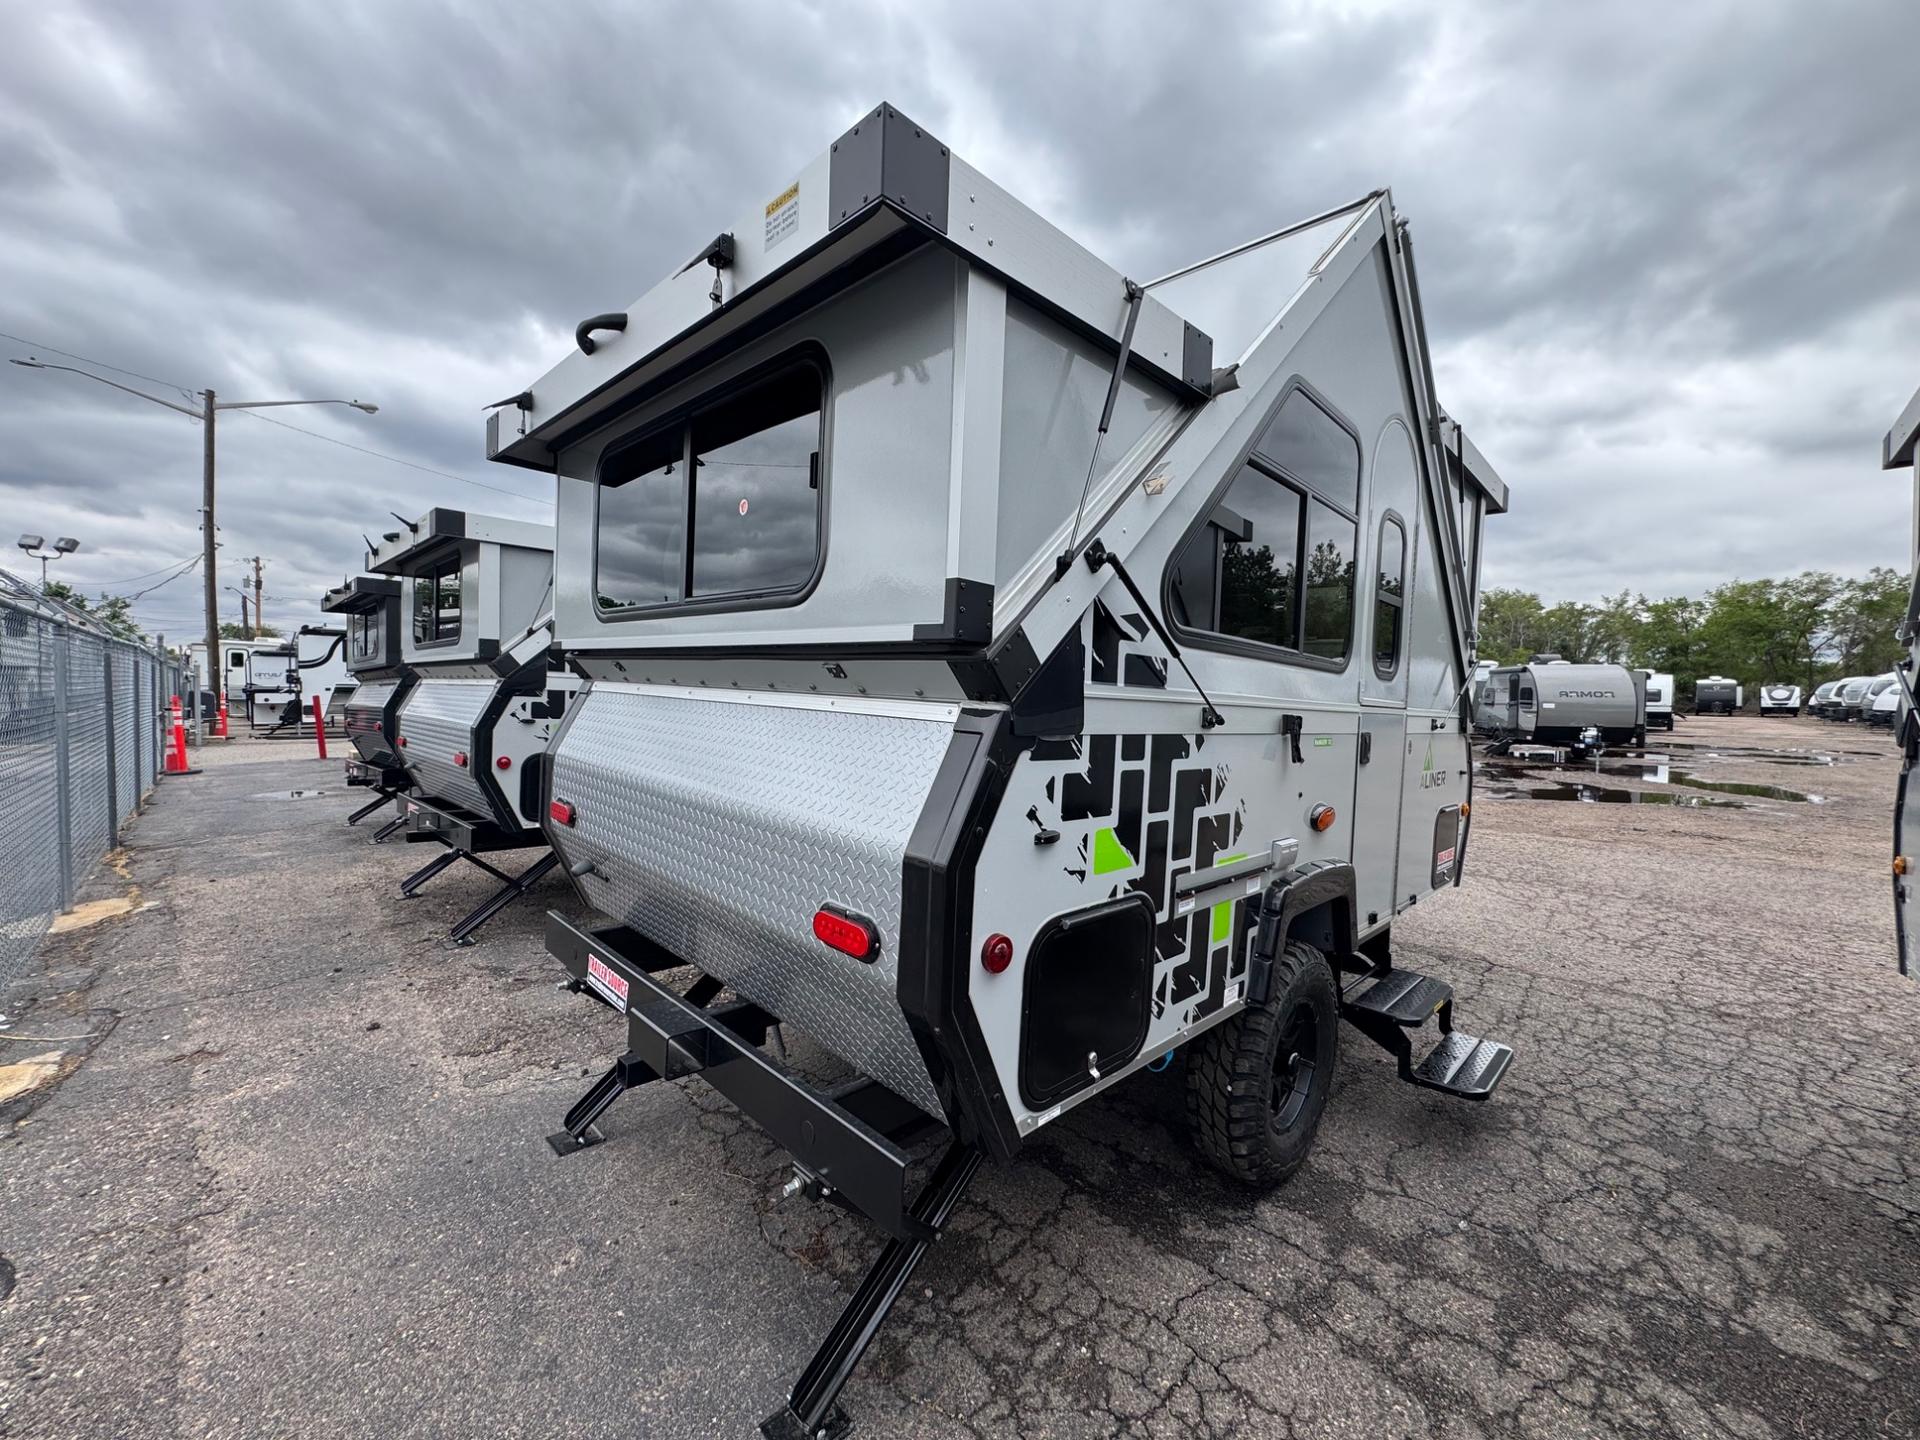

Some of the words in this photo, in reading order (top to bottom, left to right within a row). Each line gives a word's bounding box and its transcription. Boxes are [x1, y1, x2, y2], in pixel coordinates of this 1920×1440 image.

[771, 181, 800, 211] CAUTION
[1558, 690, 1616, 699] ARMOR
[1419, 770, 1447, 790] ALINER
[589, 956, 608, 982] TRAILER
[607, 970, 629, 998] SOURCE
